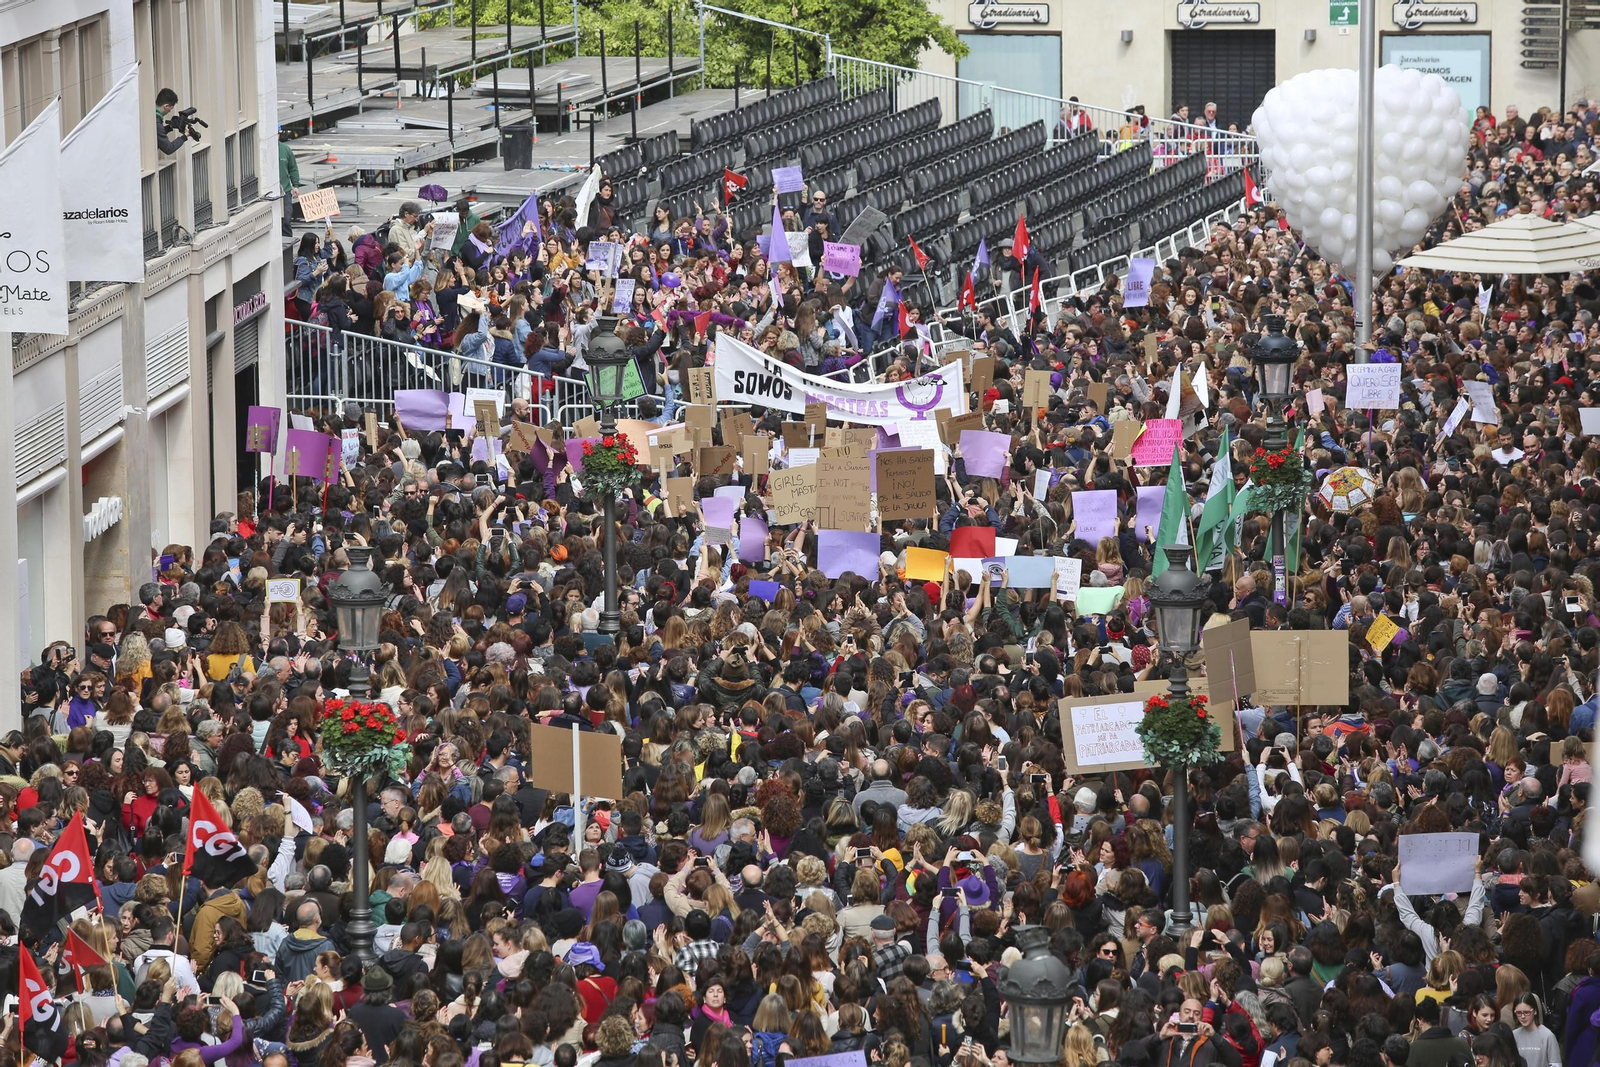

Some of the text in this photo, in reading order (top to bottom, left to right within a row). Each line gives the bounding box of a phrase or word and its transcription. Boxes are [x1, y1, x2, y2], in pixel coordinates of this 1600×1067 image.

[981, 5, 1043, 24] Stradivarius
[1189, 5, 1252, 24] Stradivarius
[1406, 3, 1469, 23] Stradivarius
[1127, 280, 1144, 291] LIBRE
[734, 370, 793, 401] SOMOS
[1350, 374, 1400, 388] QUIERO SER
[1361, 389, 1382, 400] LIBRE
[897, 456, 907, 464] HA
[773, 474, 804, 491] GIRLS
[833, 478, 850, 488] NOT
[879, 494, 888, 502] OS
[777, 502, 801, 517] BOYS
[880, 505, 890, 513] DE
[892, 503, 901, 511] LA
[1080, 525, 1097, 533] LIBRE
[1093, 706, 1109, 721] EL
[1075, 720, 1133, 736] PATRIARCADO
